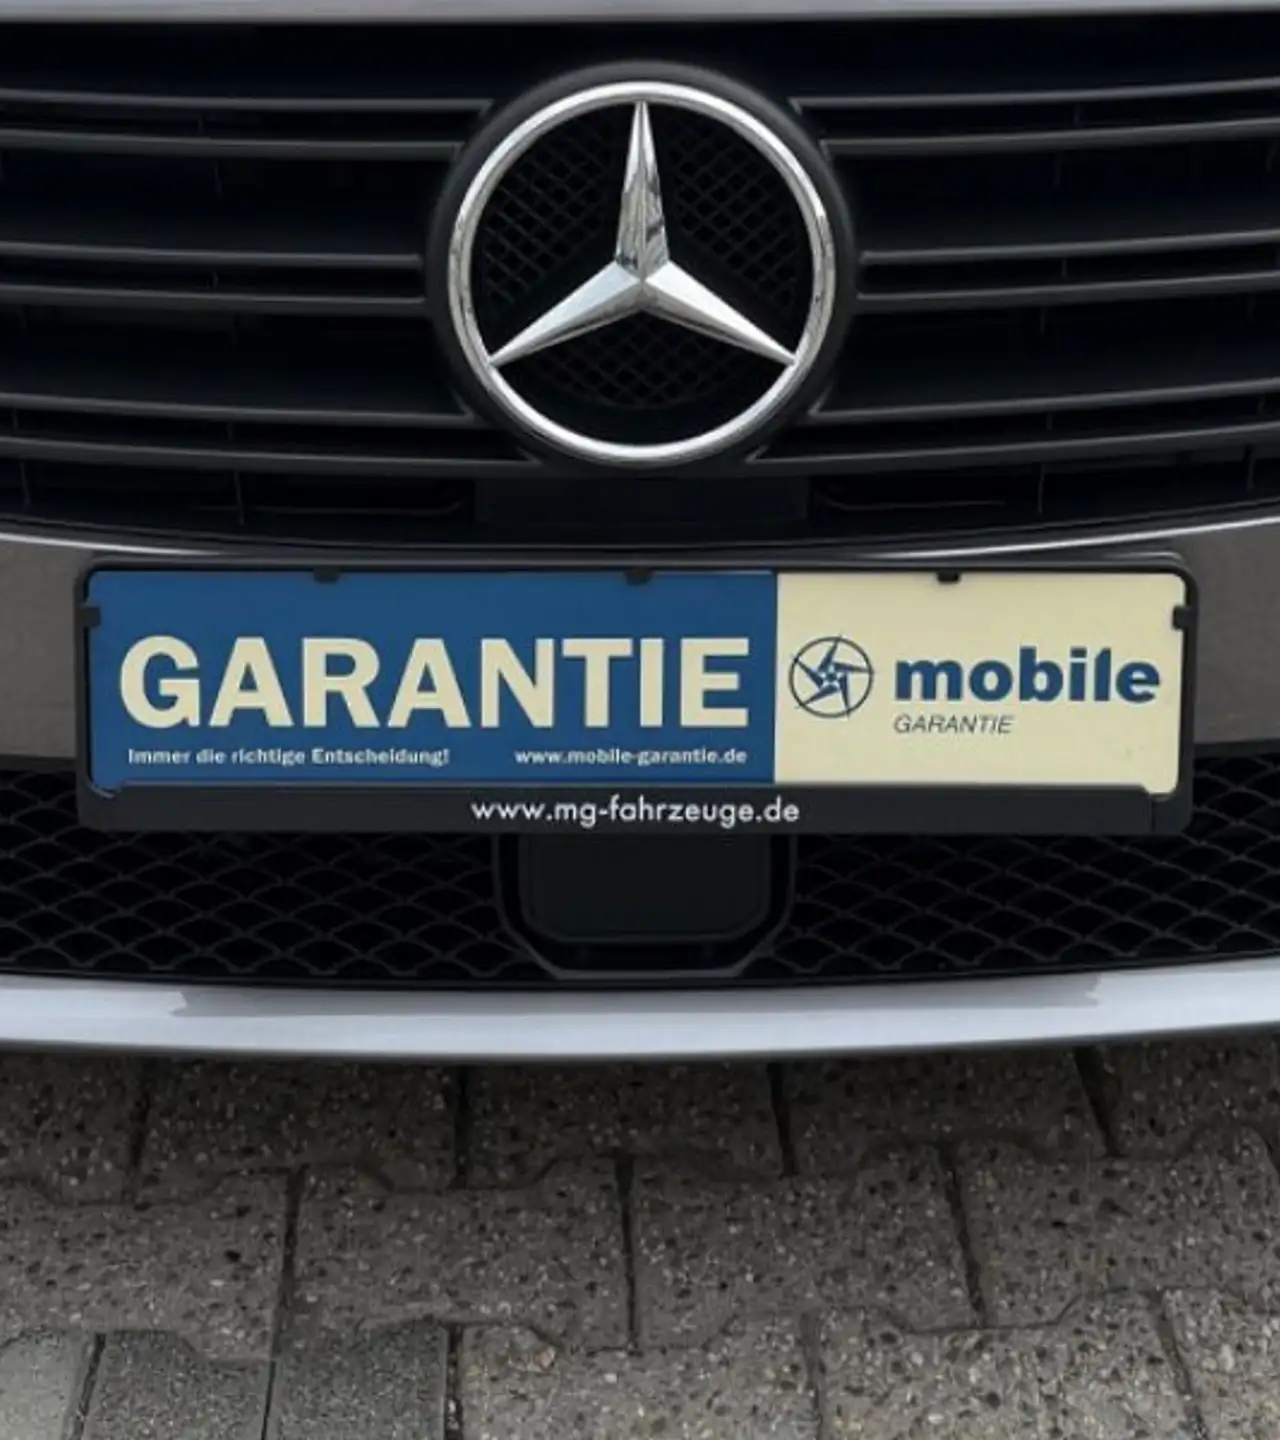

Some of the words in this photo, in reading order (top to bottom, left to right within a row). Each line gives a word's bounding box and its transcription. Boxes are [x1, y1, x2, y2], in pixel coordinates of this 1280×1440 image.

[120, 635, 749, 728] GARANTIE
[895, 646, 1160, 703] mobile
[893, 714, 1014, 734] GARANTIE
[128, 748, 191, 764] Immer
[196, 748, 224, 765] die
[231, 748, 305, 767] richtige
[311, 748, 450, 767] Entscheidung!
[514, 748, 747, 766] www.mobile-garantie.de
[471, 794, 800, 829] www.mg-fahrzeuge.de
